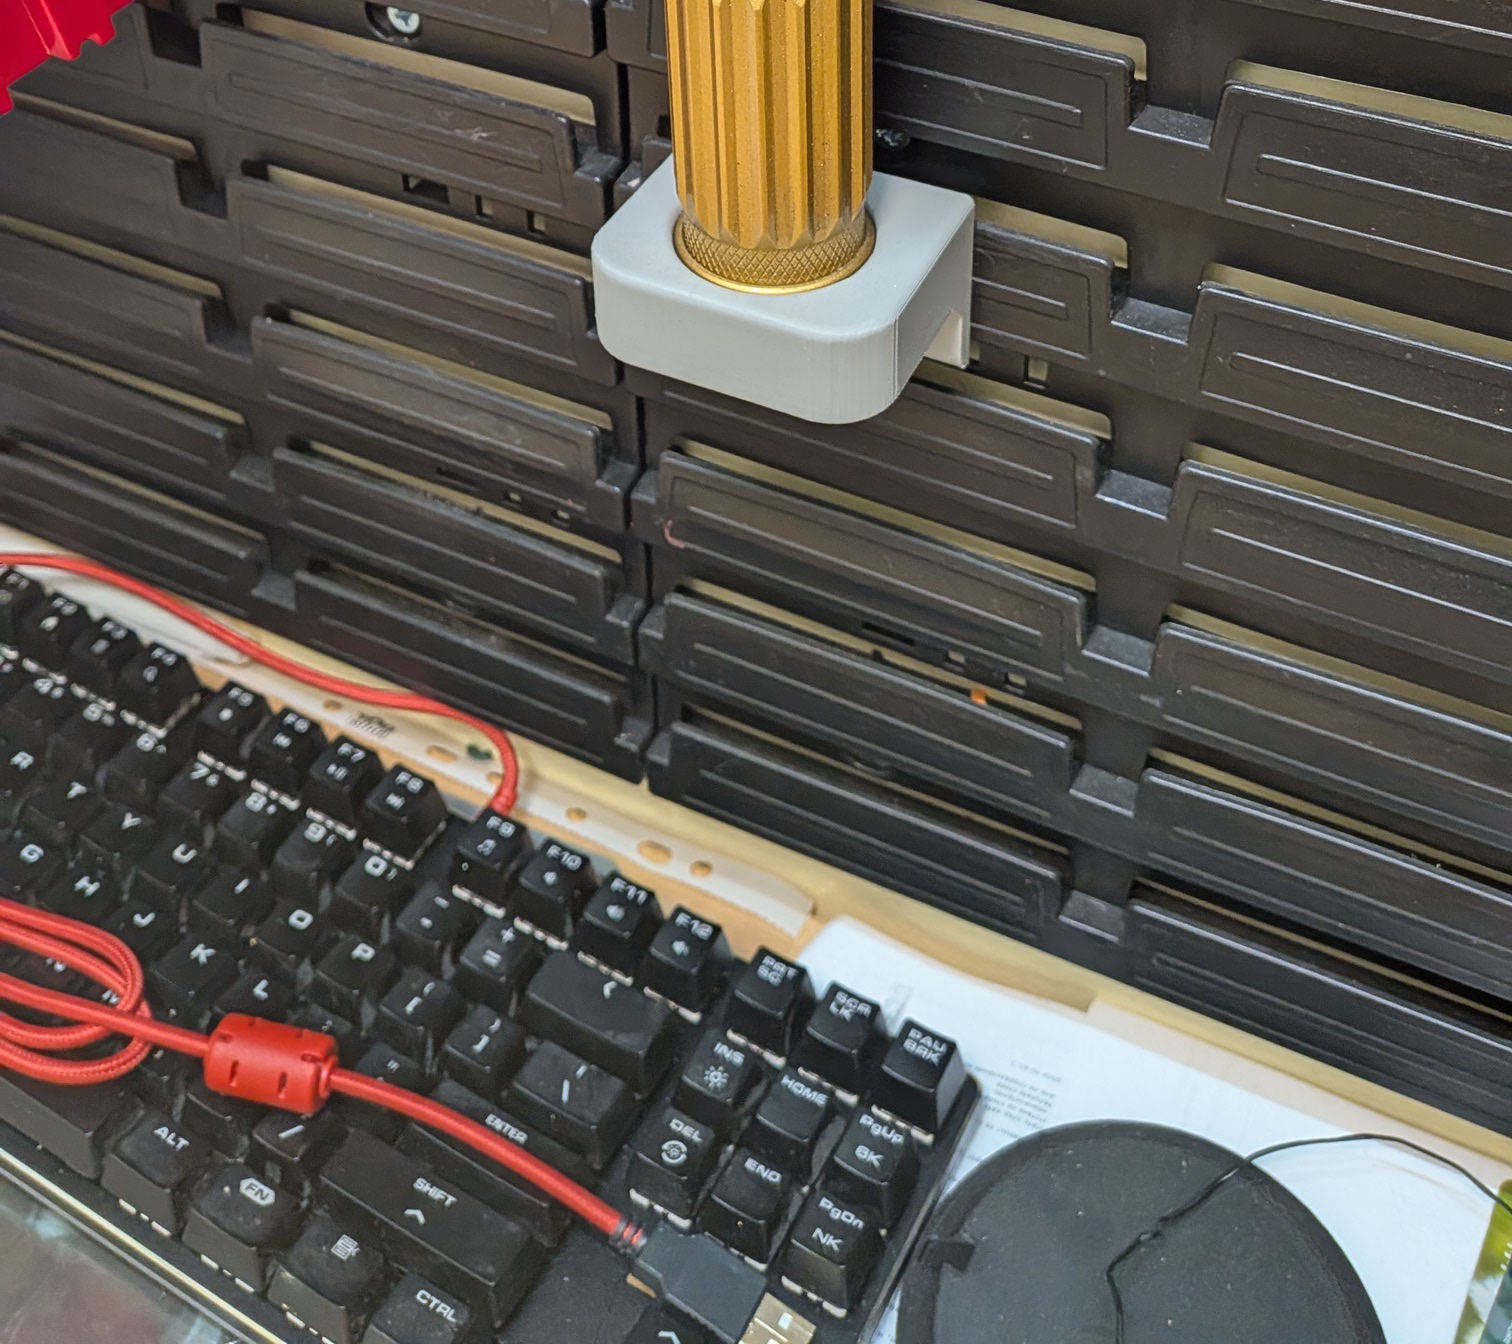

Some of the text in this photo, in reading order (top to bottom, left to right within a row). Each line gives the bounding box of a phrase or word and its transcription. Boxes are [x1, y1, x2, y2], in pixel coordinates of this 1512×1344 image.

[9, 751, 35, 771] R
[337, 742, 366, 762] F7
[66, 781, 88, 800] T
[121, 812, 142, 830] Y
[172, 843, 198, 864] U
[546, 844, 582, 871] F10
[73, 875, 101, 898] H
[610, 877, 648, 905] F11
[132, 912, 156, 928] J
[674, 912, 714, 941] F12
[189, 943, 217, 967] K
[351, 942, 377, 962] P
[252, 978, 269, 1001] L
[829, 1001, 855, 1022] LK
[908, 1028, 948, 1053] PAU
[713, 1042, 745, 1067] INS
[781, 1075, 829, 1107] HOME
[153, 1126, 190, 1151] ALT
[485, 1113, 529, 1145] ENTER
[669, 1118, 703, 1143] DEL
[859, 1114, 905, 1144] PgUp
[744, 1157, 783, 1183] END
[244, 1182, 271, 1202] FN
[413, 1177, 458, 1207] SHIFT
[819, 1197, 865, 1229] PgDn
[811, 1227, 844, 1252] NK
[415, 1289, 458, 1323] CTRL
